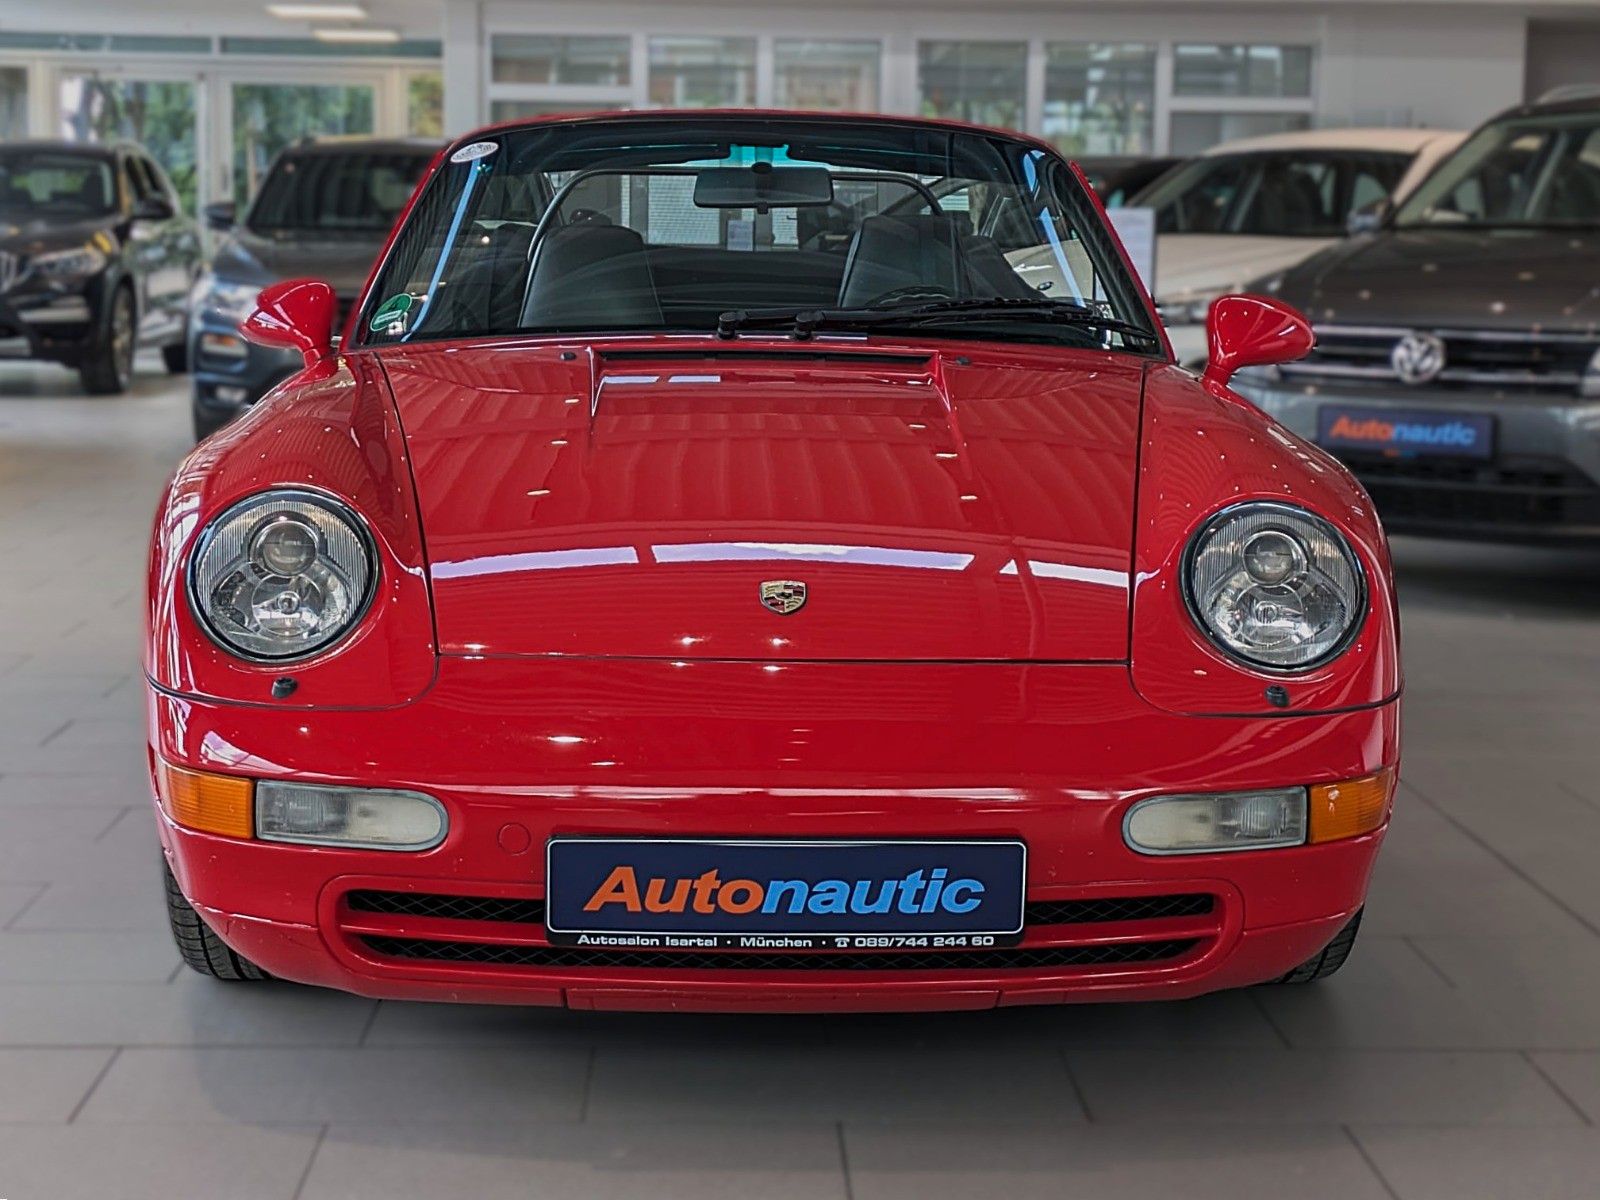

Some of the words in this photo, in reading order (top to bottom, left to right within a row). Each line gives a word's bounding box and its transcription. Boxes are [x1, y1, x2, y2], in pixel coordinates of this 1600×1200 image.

[1328, 414, 1477, 446] Autonautic
[583, 866, 985, 914] Autonautic
[577, 934, 660, 946] Autosalon
[665, 936, 718, 947] Isartal
[740, 937, 813, 948] München
[854, 937, 928, 948] 089/744
[933, 936, 967, 947] 244
[971, 936, 995, 946] 60
